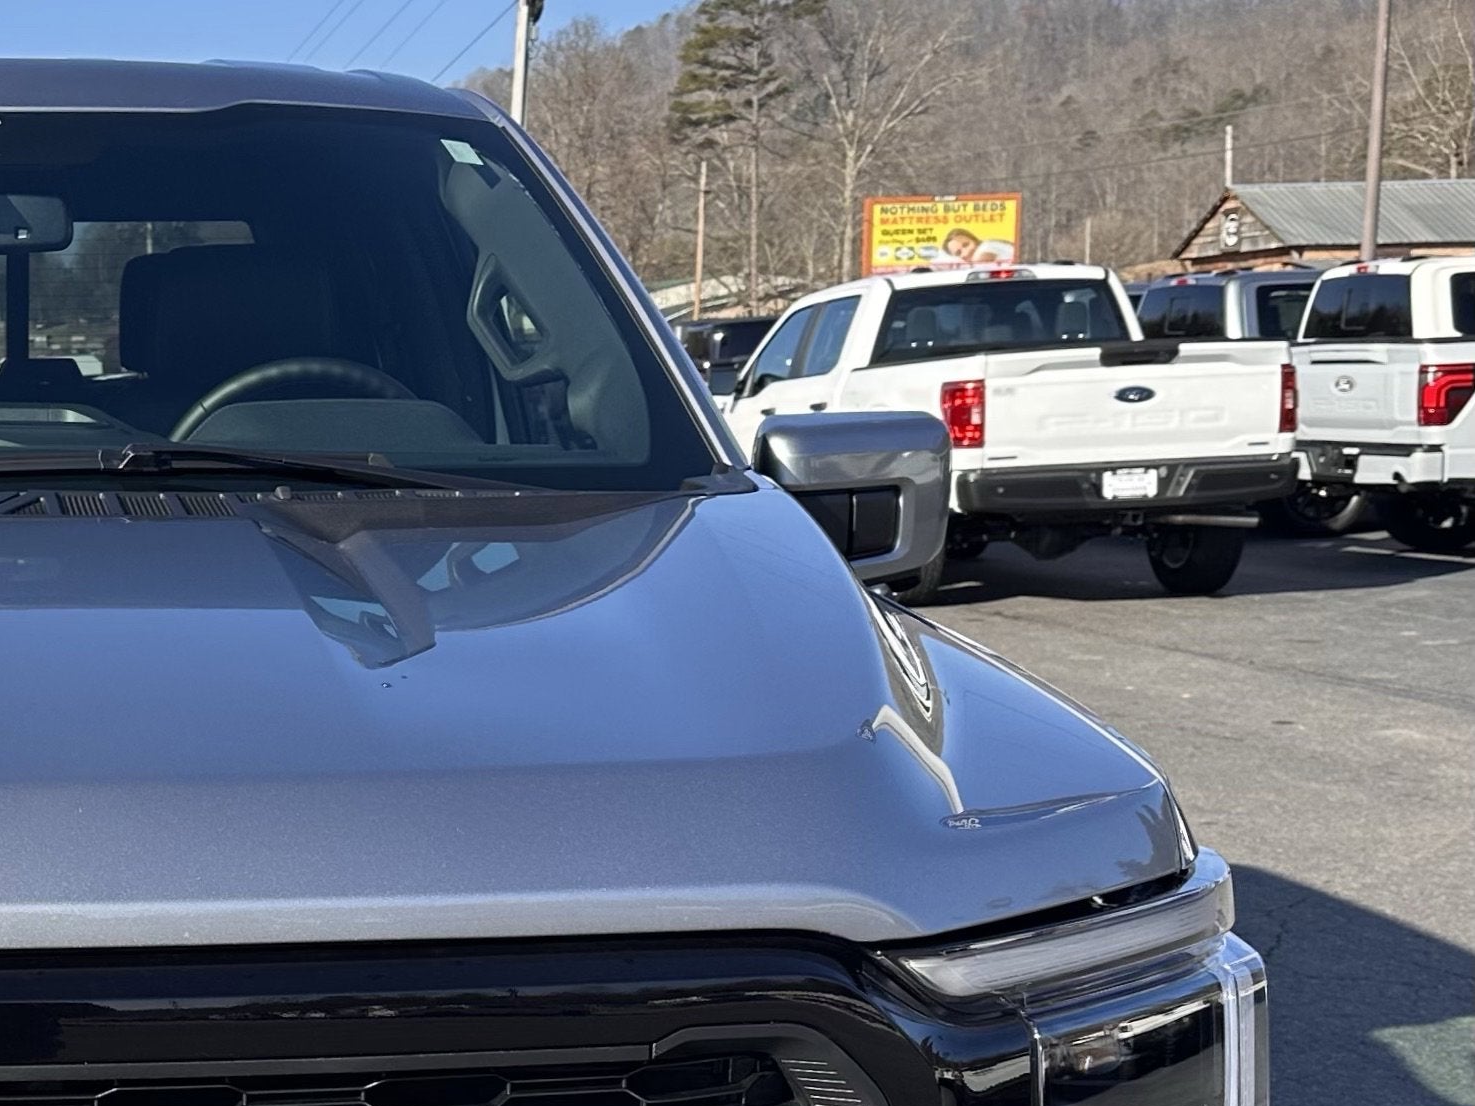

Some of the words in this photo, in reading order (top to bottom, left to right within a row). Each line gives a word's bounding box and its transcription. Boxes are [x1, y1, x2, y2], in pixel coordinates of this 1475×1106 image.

[880, 204, 938, 215] NOTHING
[944, 203, 968, 213] BUT
[973, 202, 1006, 212] BEDS
[880, 214, 949, 225] MATTRESS
[954, 213, 1005, 223] OUTLET
